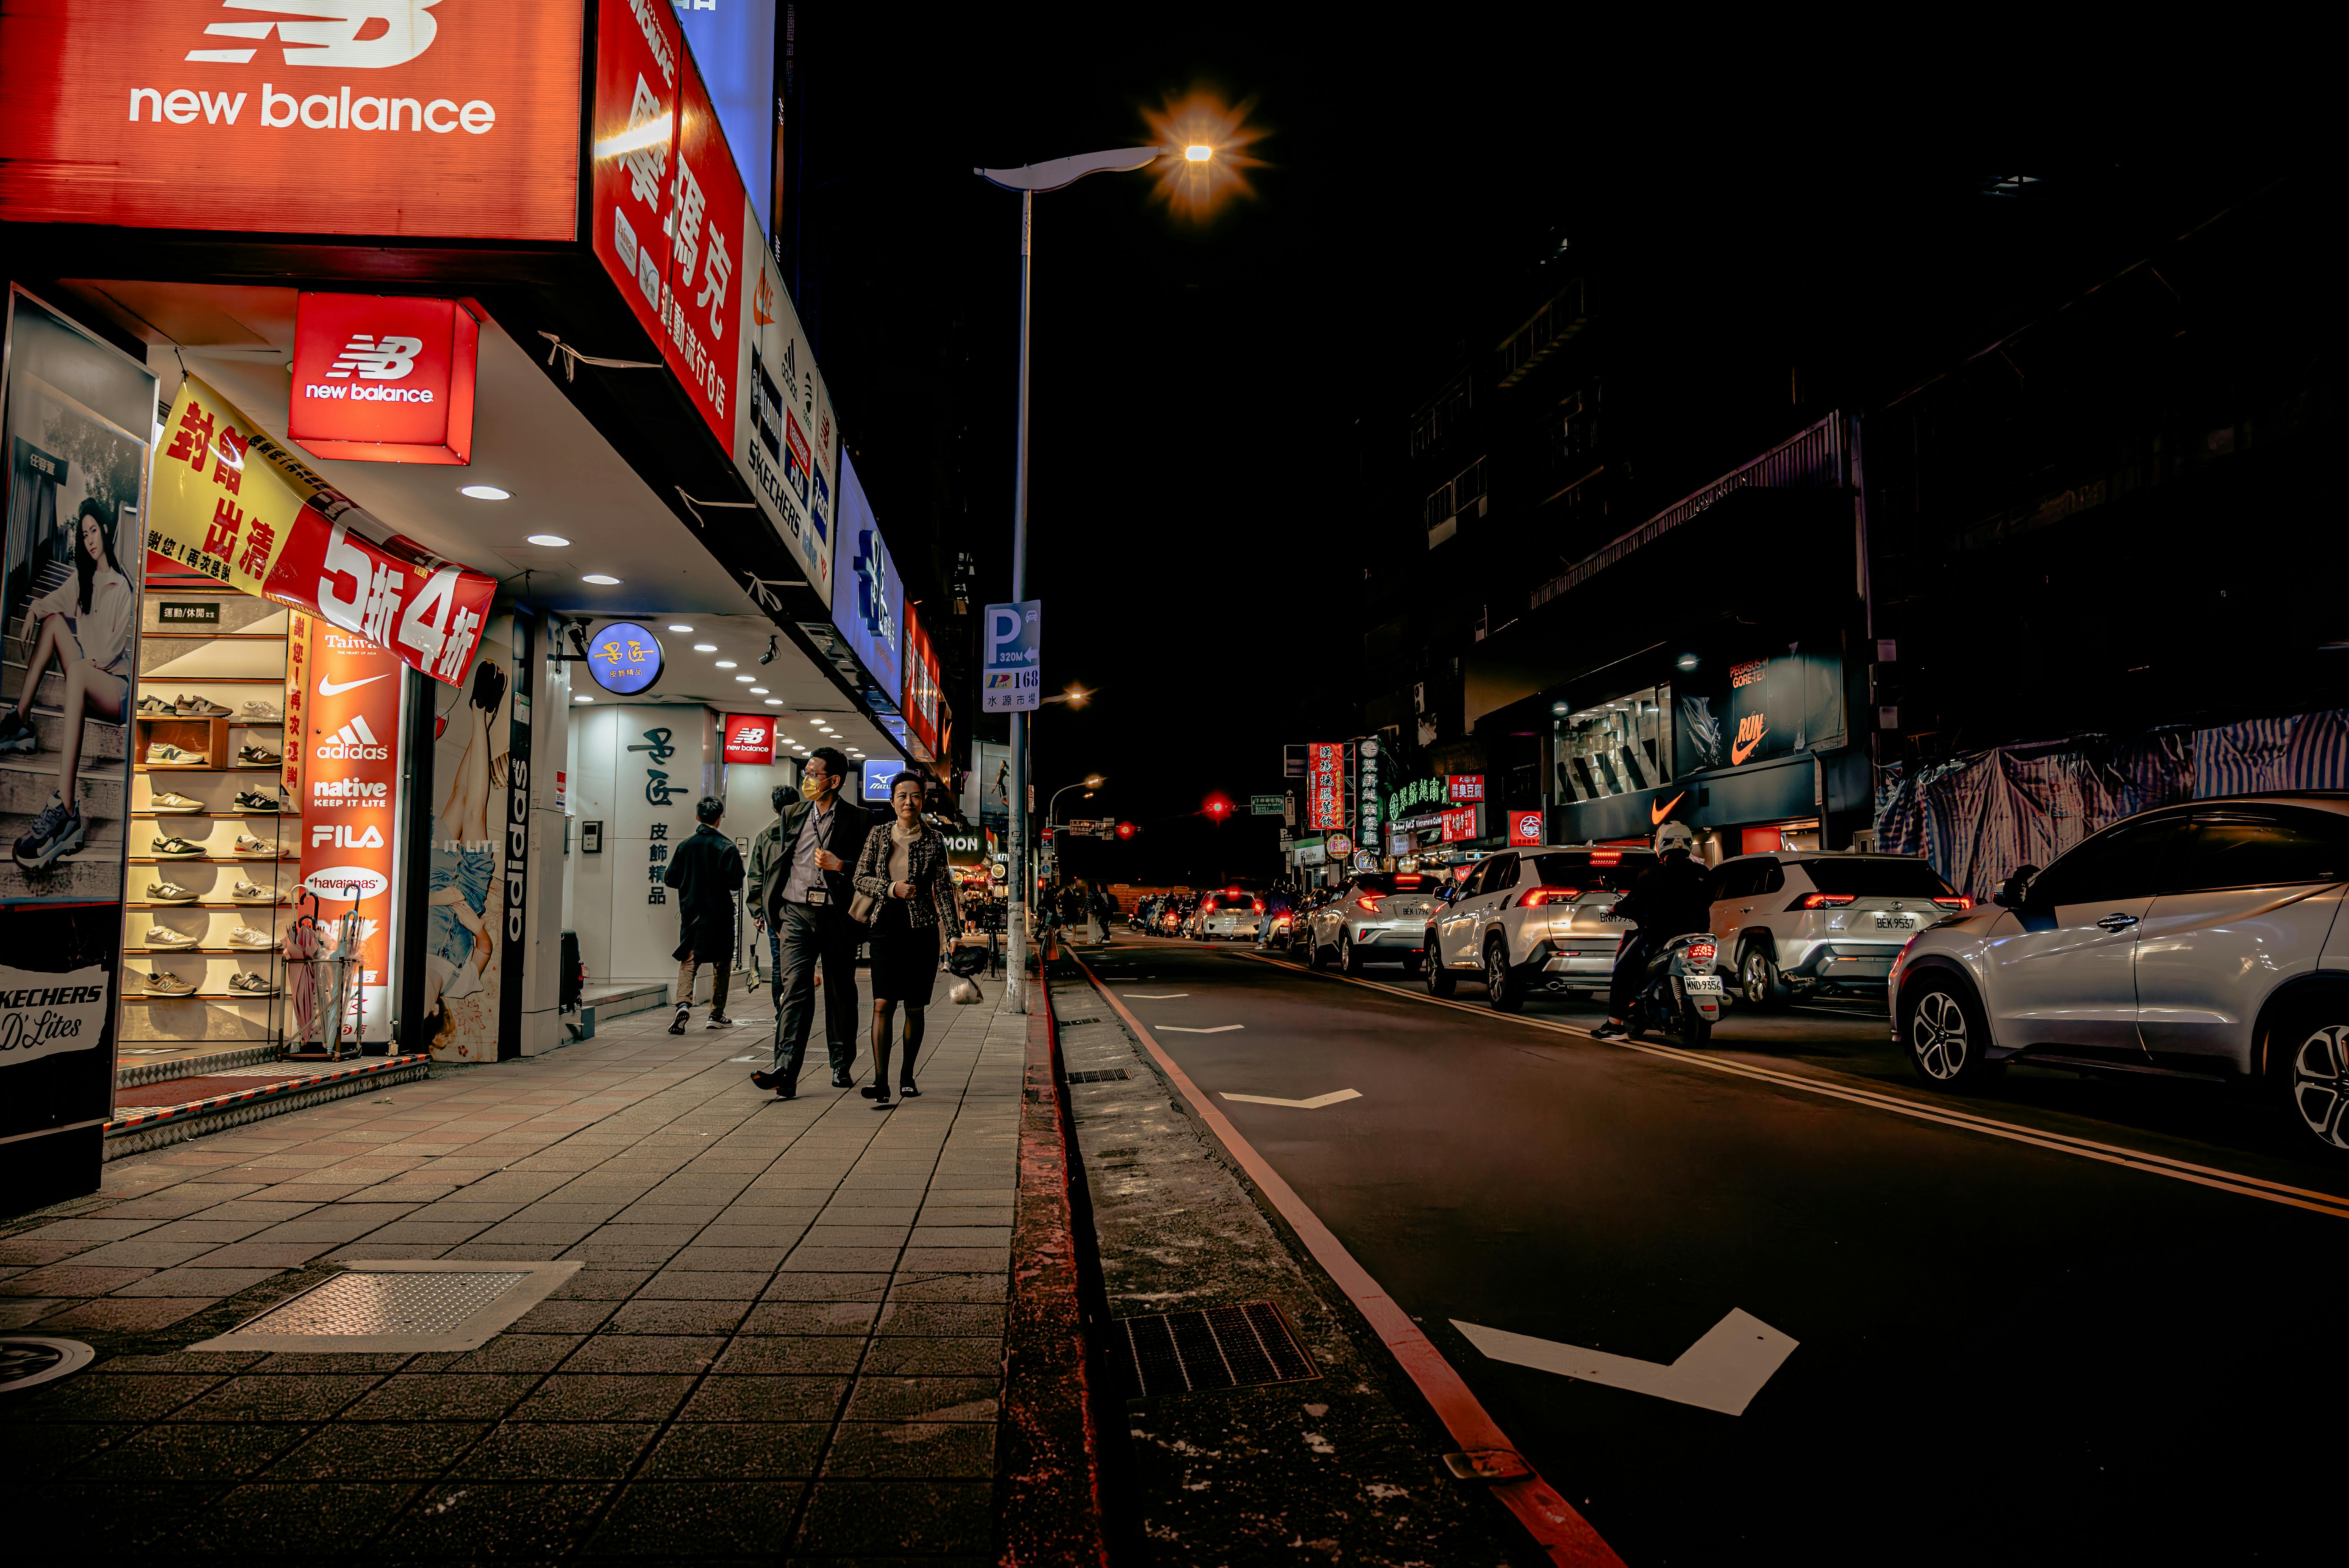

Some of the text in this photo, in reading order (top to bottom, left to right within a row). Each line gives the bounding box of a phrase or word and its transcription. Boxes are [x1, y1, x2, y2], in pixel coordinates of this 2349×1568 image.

[129, 83, 495, 134] new balance
[660, 280, 725, 420] 運動流行6店
[782, 362, 798, 403] adidas
[307, 383, 433, 403] new balance
[761, 385, 781, 444] ALLADIUM
[790, 417, 808, 467] havaianas
[748, 438, 801, 539] SKECHERS
[164, 608, 205, 618] 運動/休閒
[988, 609, 1021, 664] P
[1000, 651, 1023, 662] 320M
[610, 668, 642, 678] 皮飾精品
[1015, 670, 1038, 689] 168
[1733, 668, 1766, 688] GORE-TEX
[988, 693, 1035, 707] 水源市場
[1738, 713, 1764, 743] RUN
[316, 744, 388, 760] adidas
[314, 777, 387, 797] native
[1319, 745, 1335, 827] 漢揚燒臘餐飲
[1459, 784, 1482, 798] 臭豆腐
[362, 799, 386, 807] LITE
[1362, 759, 1378, 845] 翠薪越南餐廳
[312, 825, 384, 848] FILA
[466, 839, 501, 853] LITE
[1329, 840, 1349, 850] 便當
[507, 760, 527, 942] adidas
[648, 823, 668, 905] 皮飾精品
[314, 877, 376, 889] havaianas
[1403, 906, 1429, 916] BEK-1796
[1876, 918, 1914, 929] BEK-9537
[1687, 980, 1721, 991] MND-9356
